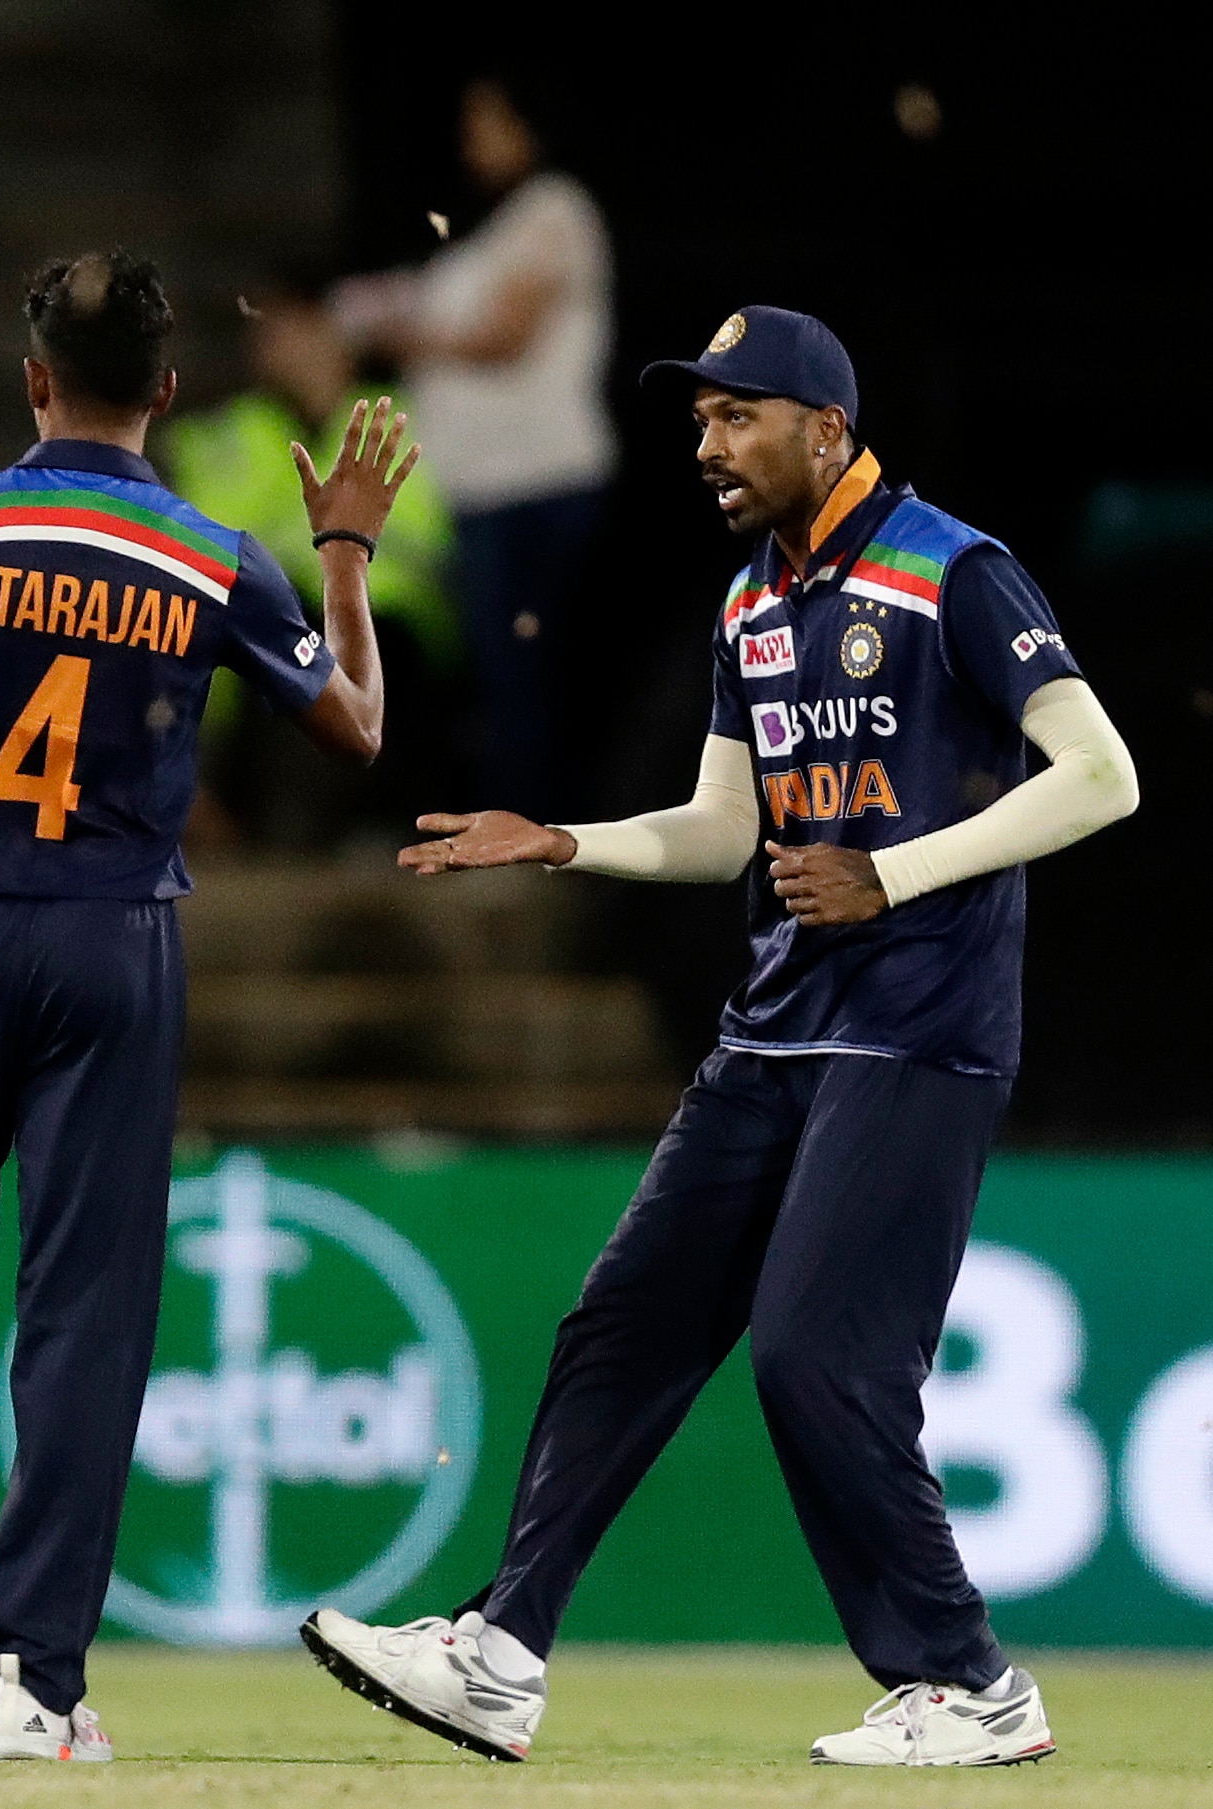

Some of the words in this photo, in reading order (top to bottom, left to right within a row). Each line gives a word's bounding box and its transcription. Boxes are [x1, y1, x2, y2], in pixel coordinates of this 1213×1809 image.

[744, 633, 791, 665] MPL
[790, 695, 897, 746] BYJU'S
[761, 758, 901, 829] INDIA
